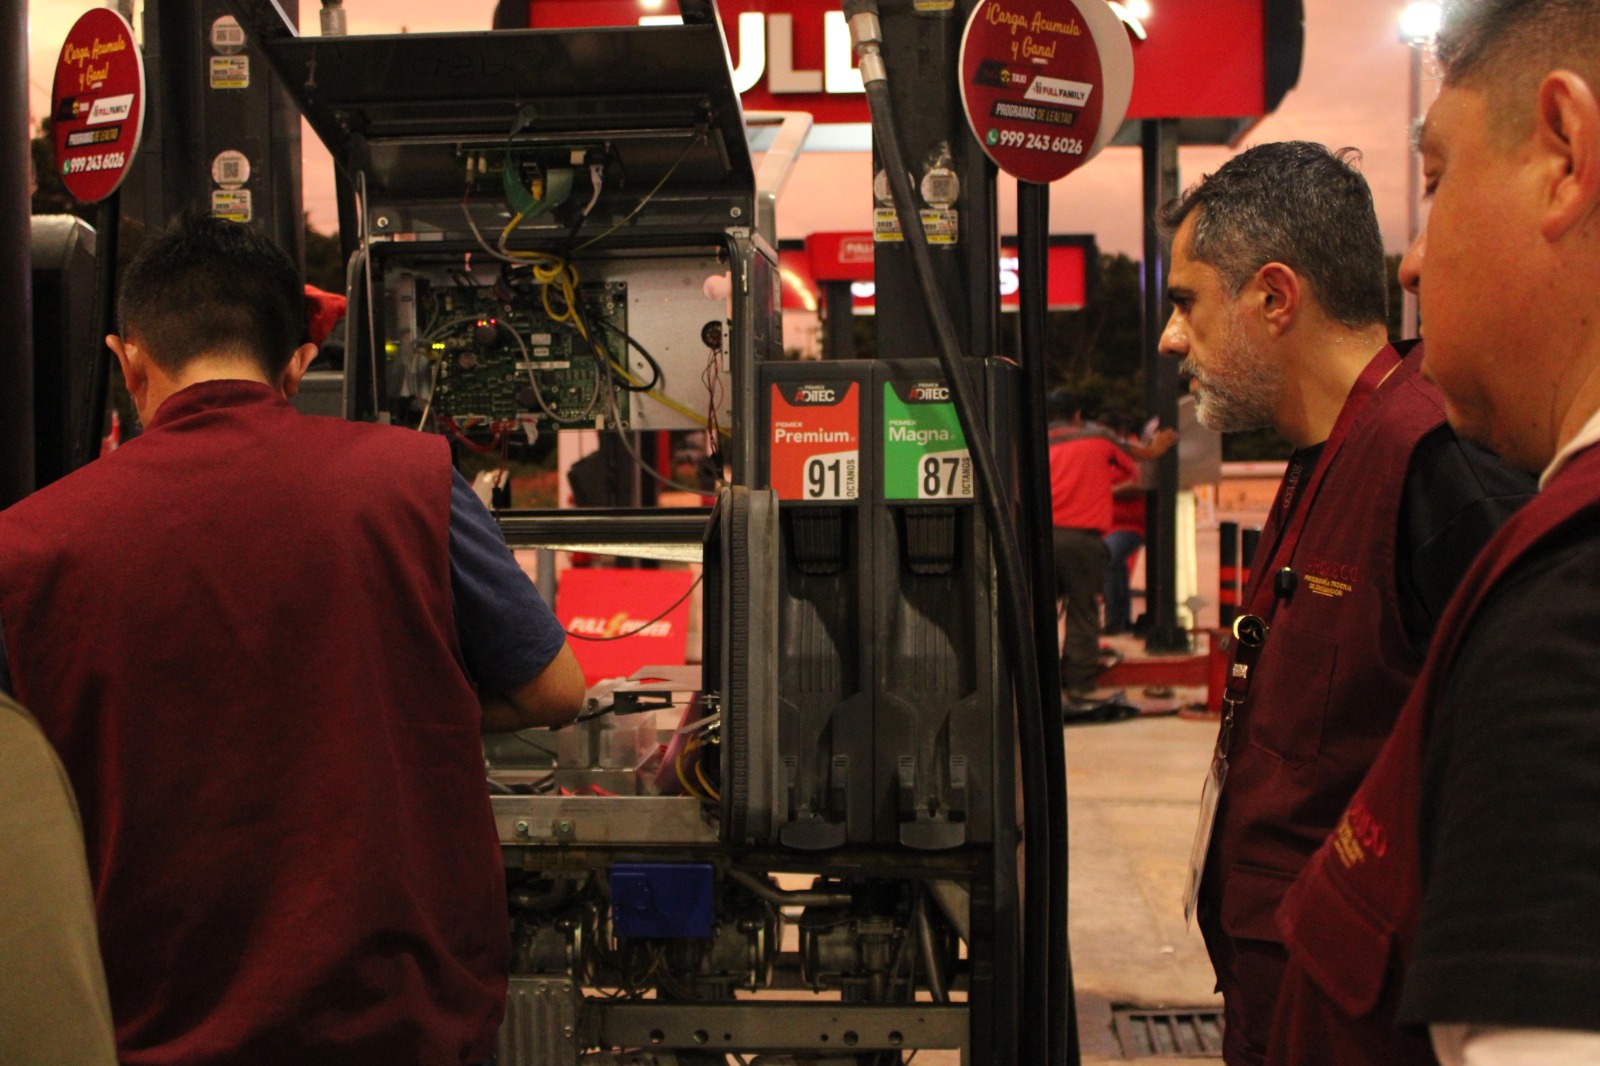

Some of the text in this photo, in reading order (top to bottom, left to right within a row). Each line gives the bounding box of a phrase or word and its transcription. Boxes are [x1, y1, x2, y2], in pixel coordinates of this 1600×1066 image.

[1031, 11, 1082, 37] Acumula
[1011, 41, 1019, 61] y
[1023, 35, 1057, 58] Gana!
[996, 102, 1036, 120] PROGRAMAS
[1037, 108, 1046, 120] DE
[1000, 130, 1083, 155] 999 243 6026
[70, 152, 125, 173] 999 243 6026
[774, 427, 849, 443] Premium
[889, 426, 949, 446] Magna
[808, 459, 841, 498] 91
[846, 459, 855, 498] OCTANOS
[923, 457, 960, 497] 87
[961, 456, 971, 495] OCTANOS
